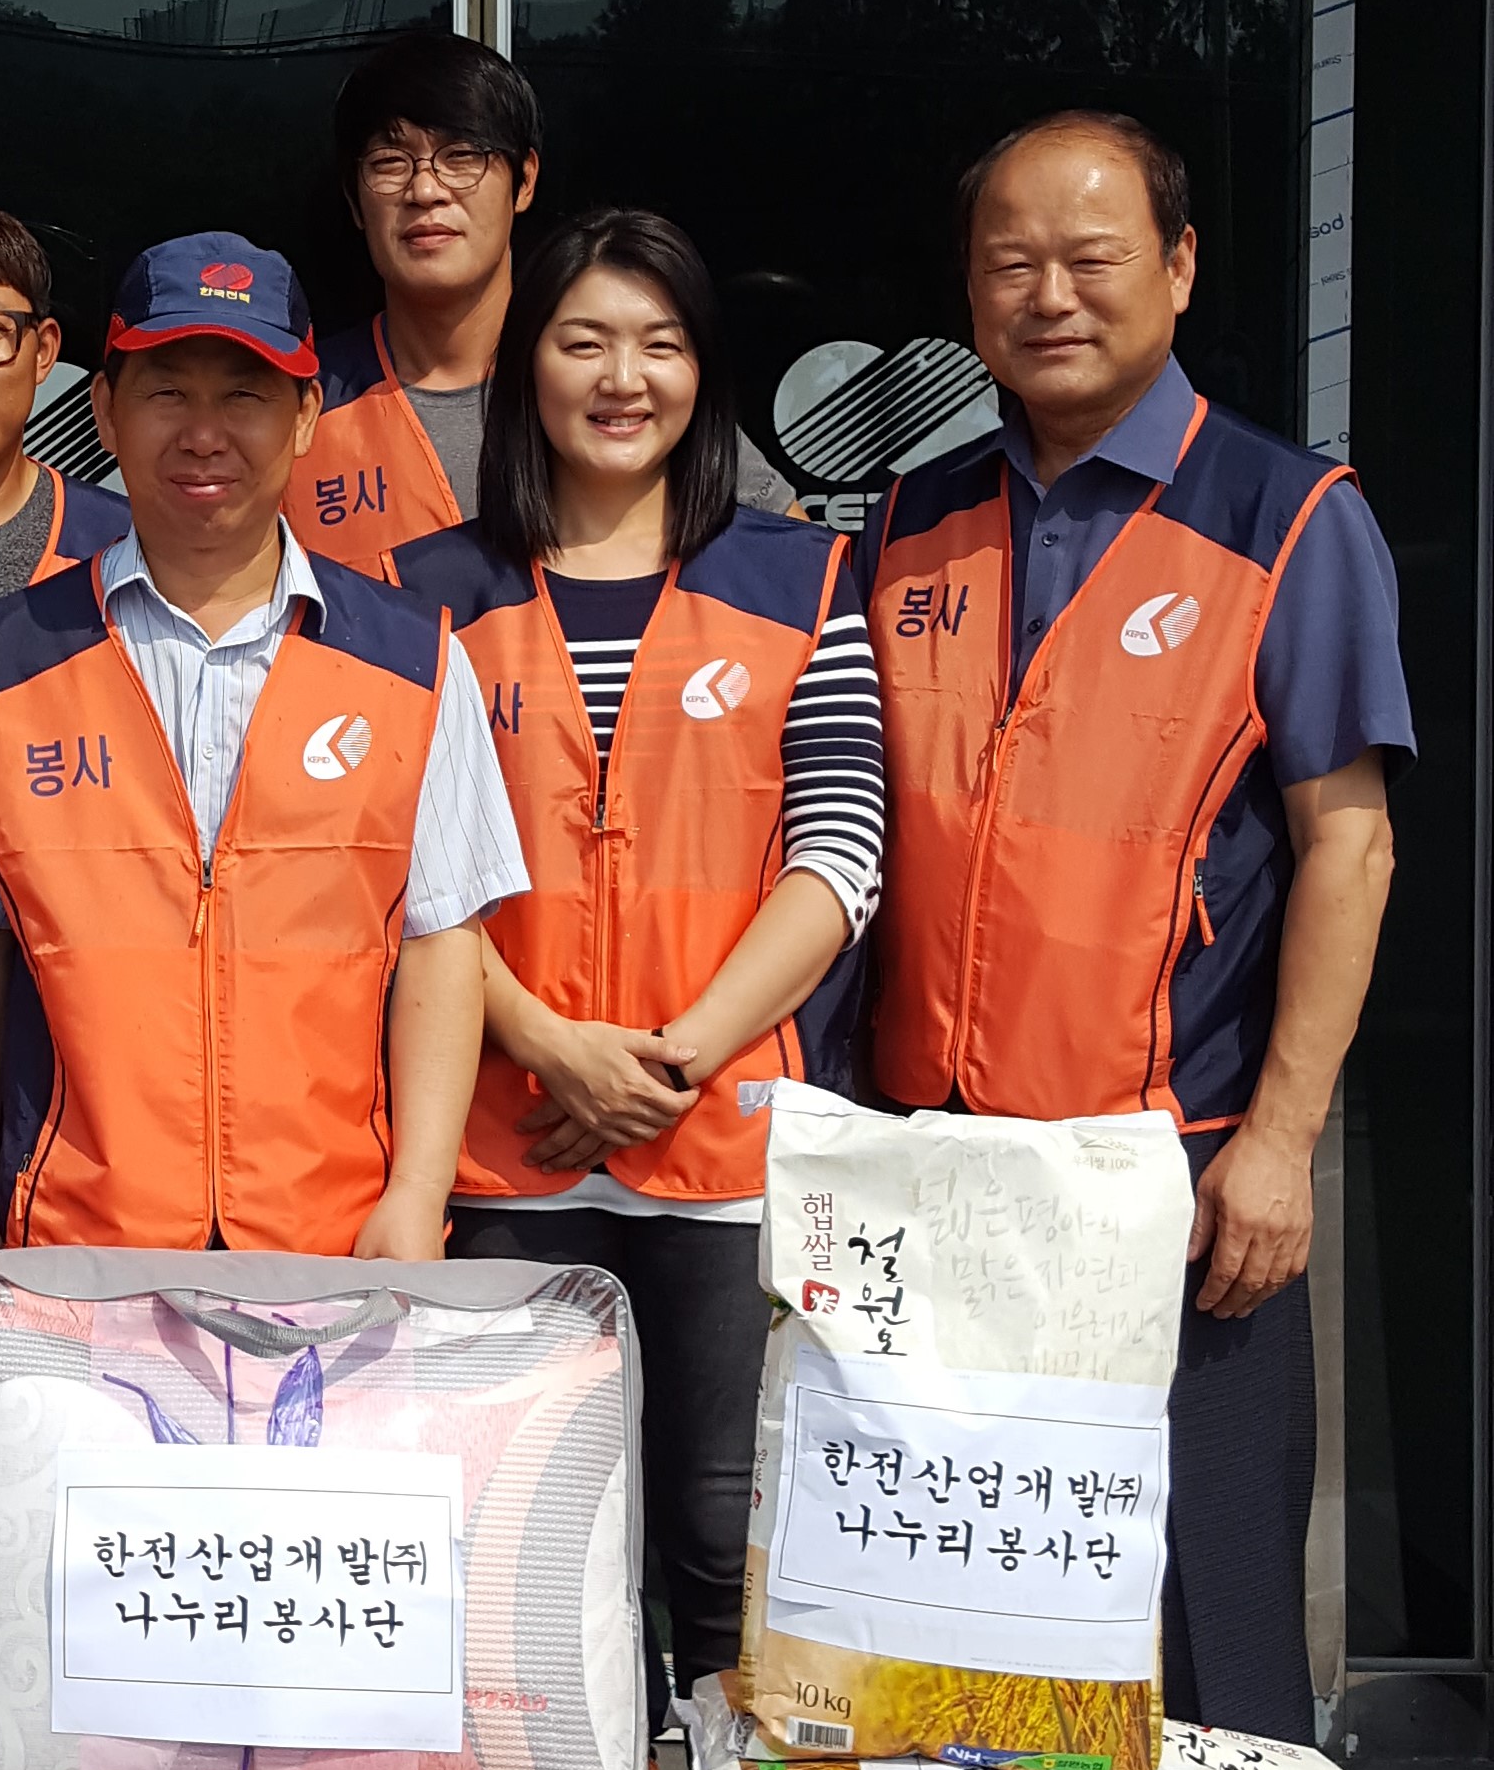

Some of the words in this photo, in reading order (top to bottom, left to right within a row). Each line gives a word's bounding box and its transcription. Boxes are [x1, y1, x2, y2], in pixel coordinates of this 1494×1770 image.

[314, 465, 388, 526] 봉사
[895, 583, 969, 638] 봉사
[25, 733, 113, 797] 봉사
[800, 1192, 838, 1272] 햅쌀
[821, 1438, 1142, 1518] 한전산업개발(주)
[92, 1530, 428, 1586] 한전산업개발(주)
[836, 1503, 974, 1568] 나누리
[986, 1527, 1121, 1580] 봉사단
[115, 1592, 249, 1643] 나누리
[262, 1595, 405, 1649] 봉사단
[946, 1746, 982, 1763] NH
